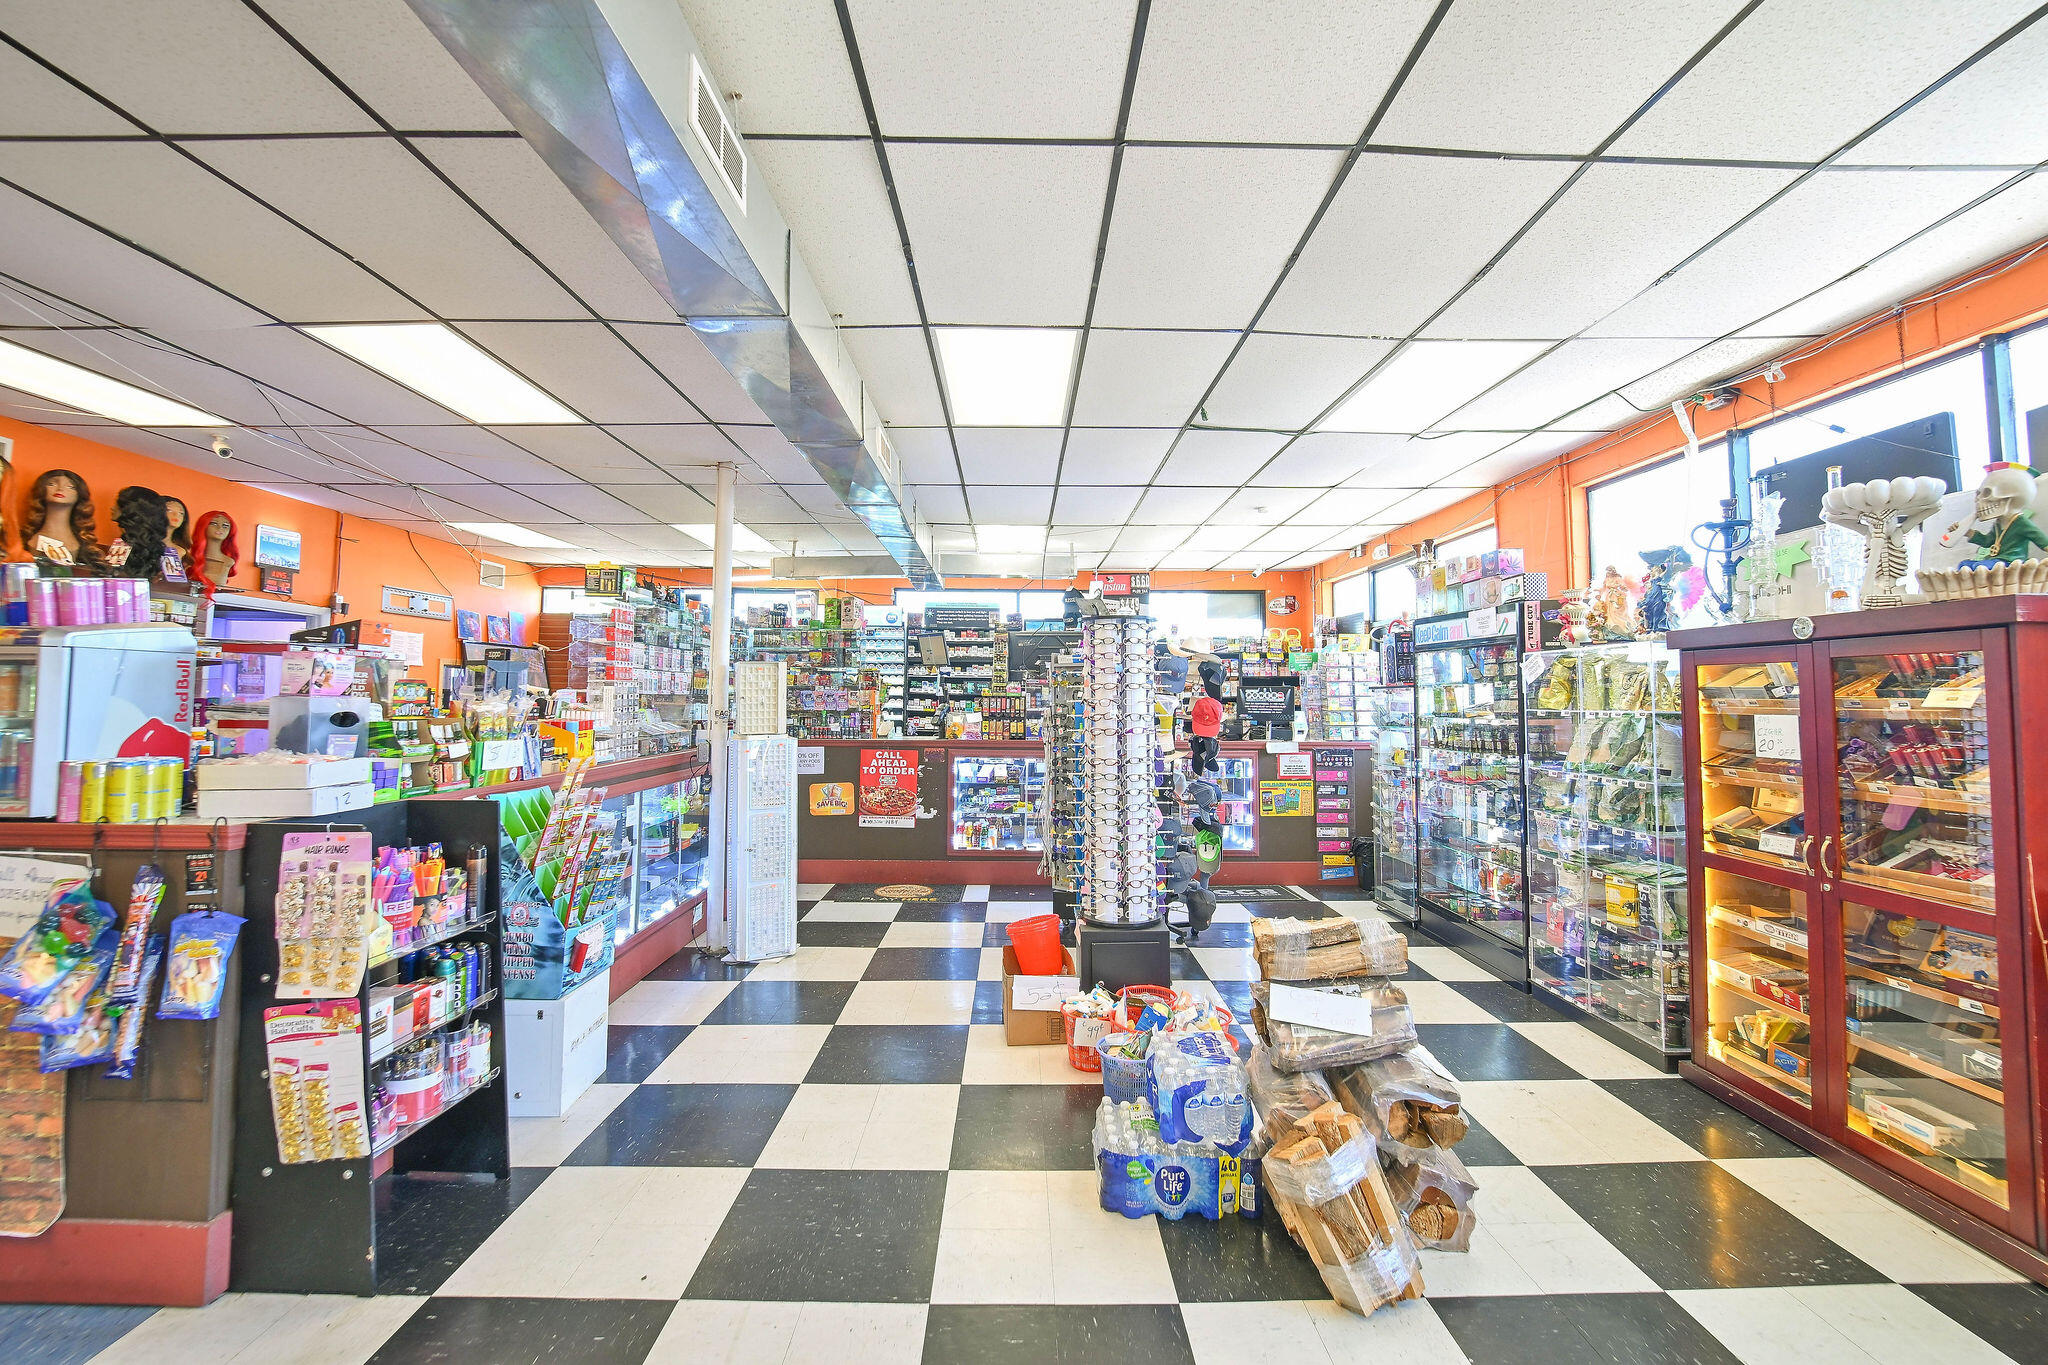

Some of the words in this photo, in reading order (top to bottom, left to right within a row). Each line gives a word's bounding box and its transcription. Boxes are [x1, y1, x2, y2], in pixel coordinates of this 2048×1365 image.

[1415, 626, 1431, 644] Keep
[1431, 624, 1449, 642] Calm
[1449, 623, 1463, 640] and
[176, 659, 191, 689] Bull
[174, 692, 189, 722] Red
[875, 751, 903, 759] CALL
[870, 759, 907, 767] AHEAD
[879, 767, 915, 775] ORDER
[816, 800, 834, 809] SAVE
[834, 800, 848, 808] BIG!
[304, 845, 323, 855] HAIR
[324, 844, 350, 854] RINGS
[386, 900, 413, 912] RED
[503, 931, 534, 943] JUMBO
[503, 968, 536, 981] NCENSE
[270, 1018, 316, 1029] Decorative
[270, 1026, 288, 1035] Hair
[291, 1024, 314, 1033] Cuffs
[1774, 1058, 1797, 1066] ACID
[1220, 1159, 1237, 1172] 40
[1160, 1168, 1185, 1182] Pure
[1162, 1179, 1184, 1192] Life
